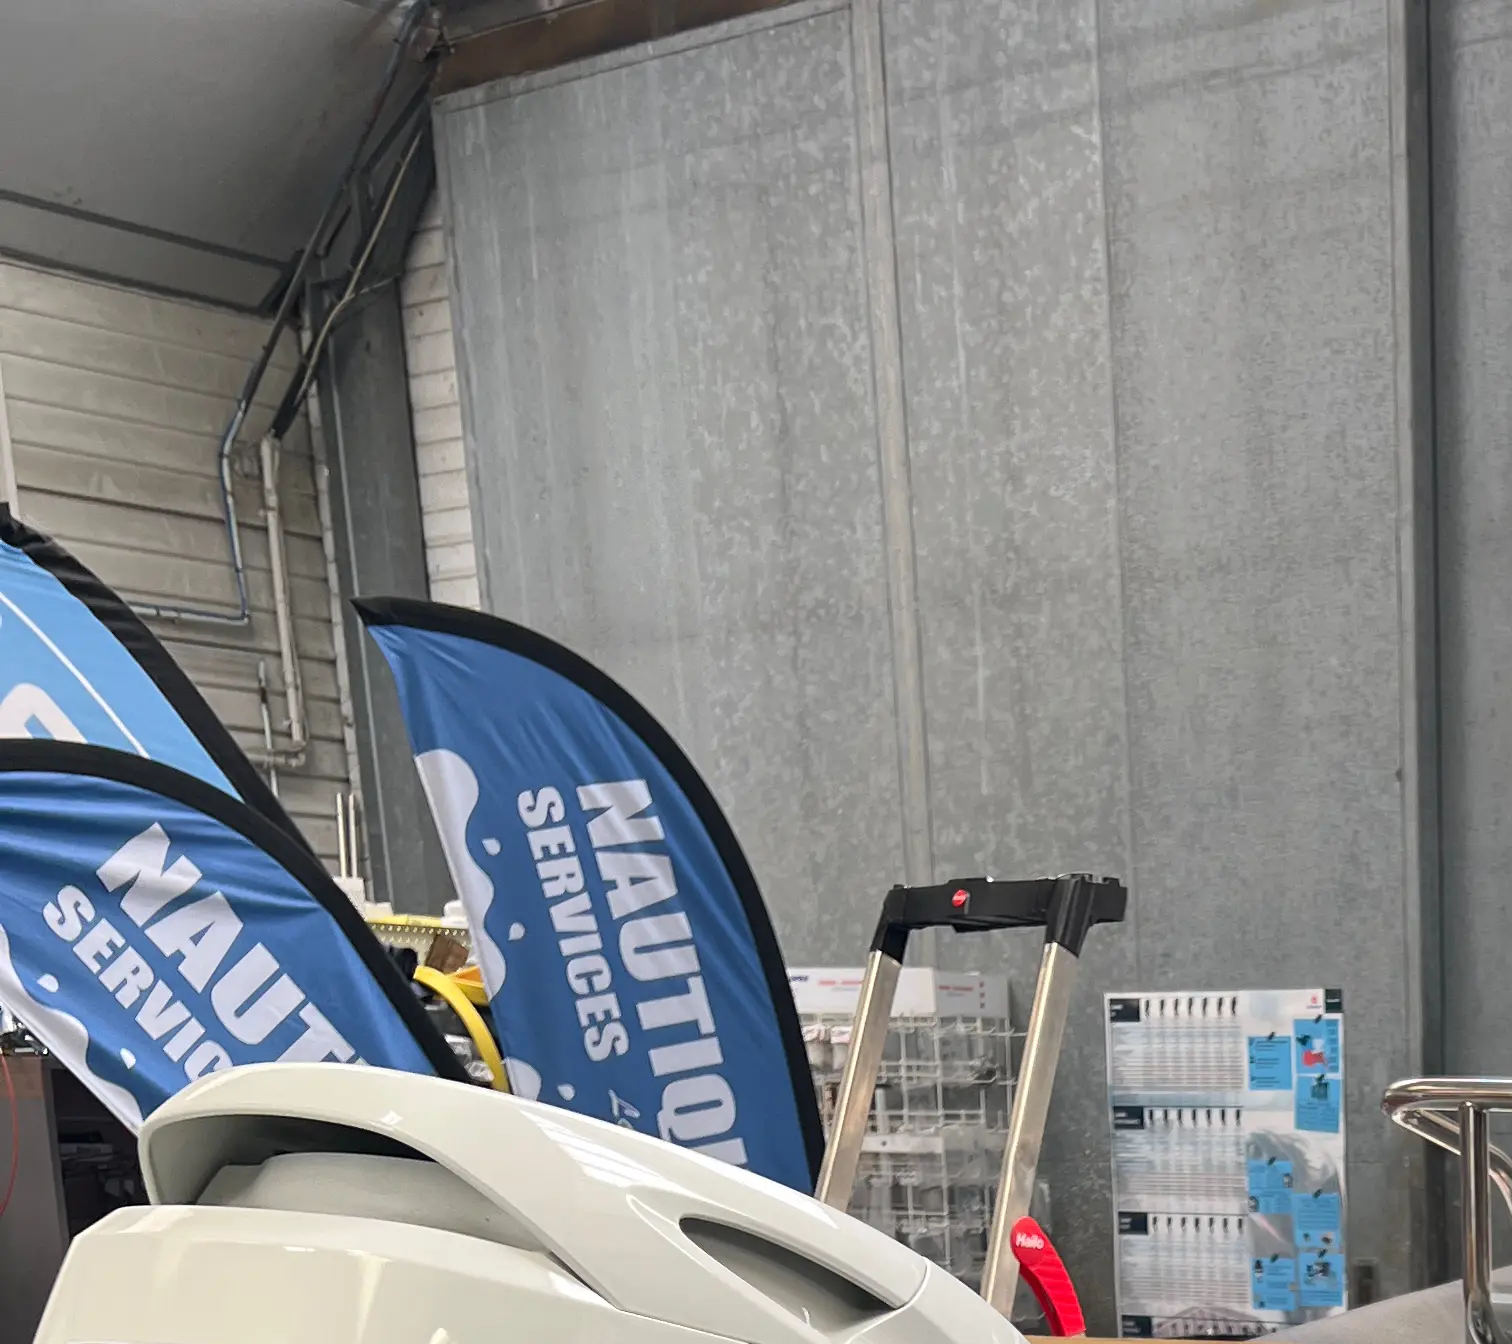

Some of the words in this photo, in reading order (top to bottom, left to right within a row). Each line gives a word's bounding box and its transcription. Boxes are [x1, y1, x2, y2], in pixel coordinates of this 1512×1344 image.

[95, 821, 371, 1066] NAUT
[516, 785, 631, 1063] SERVICES
[575, 777, 748, 1168] NAUTIQ
